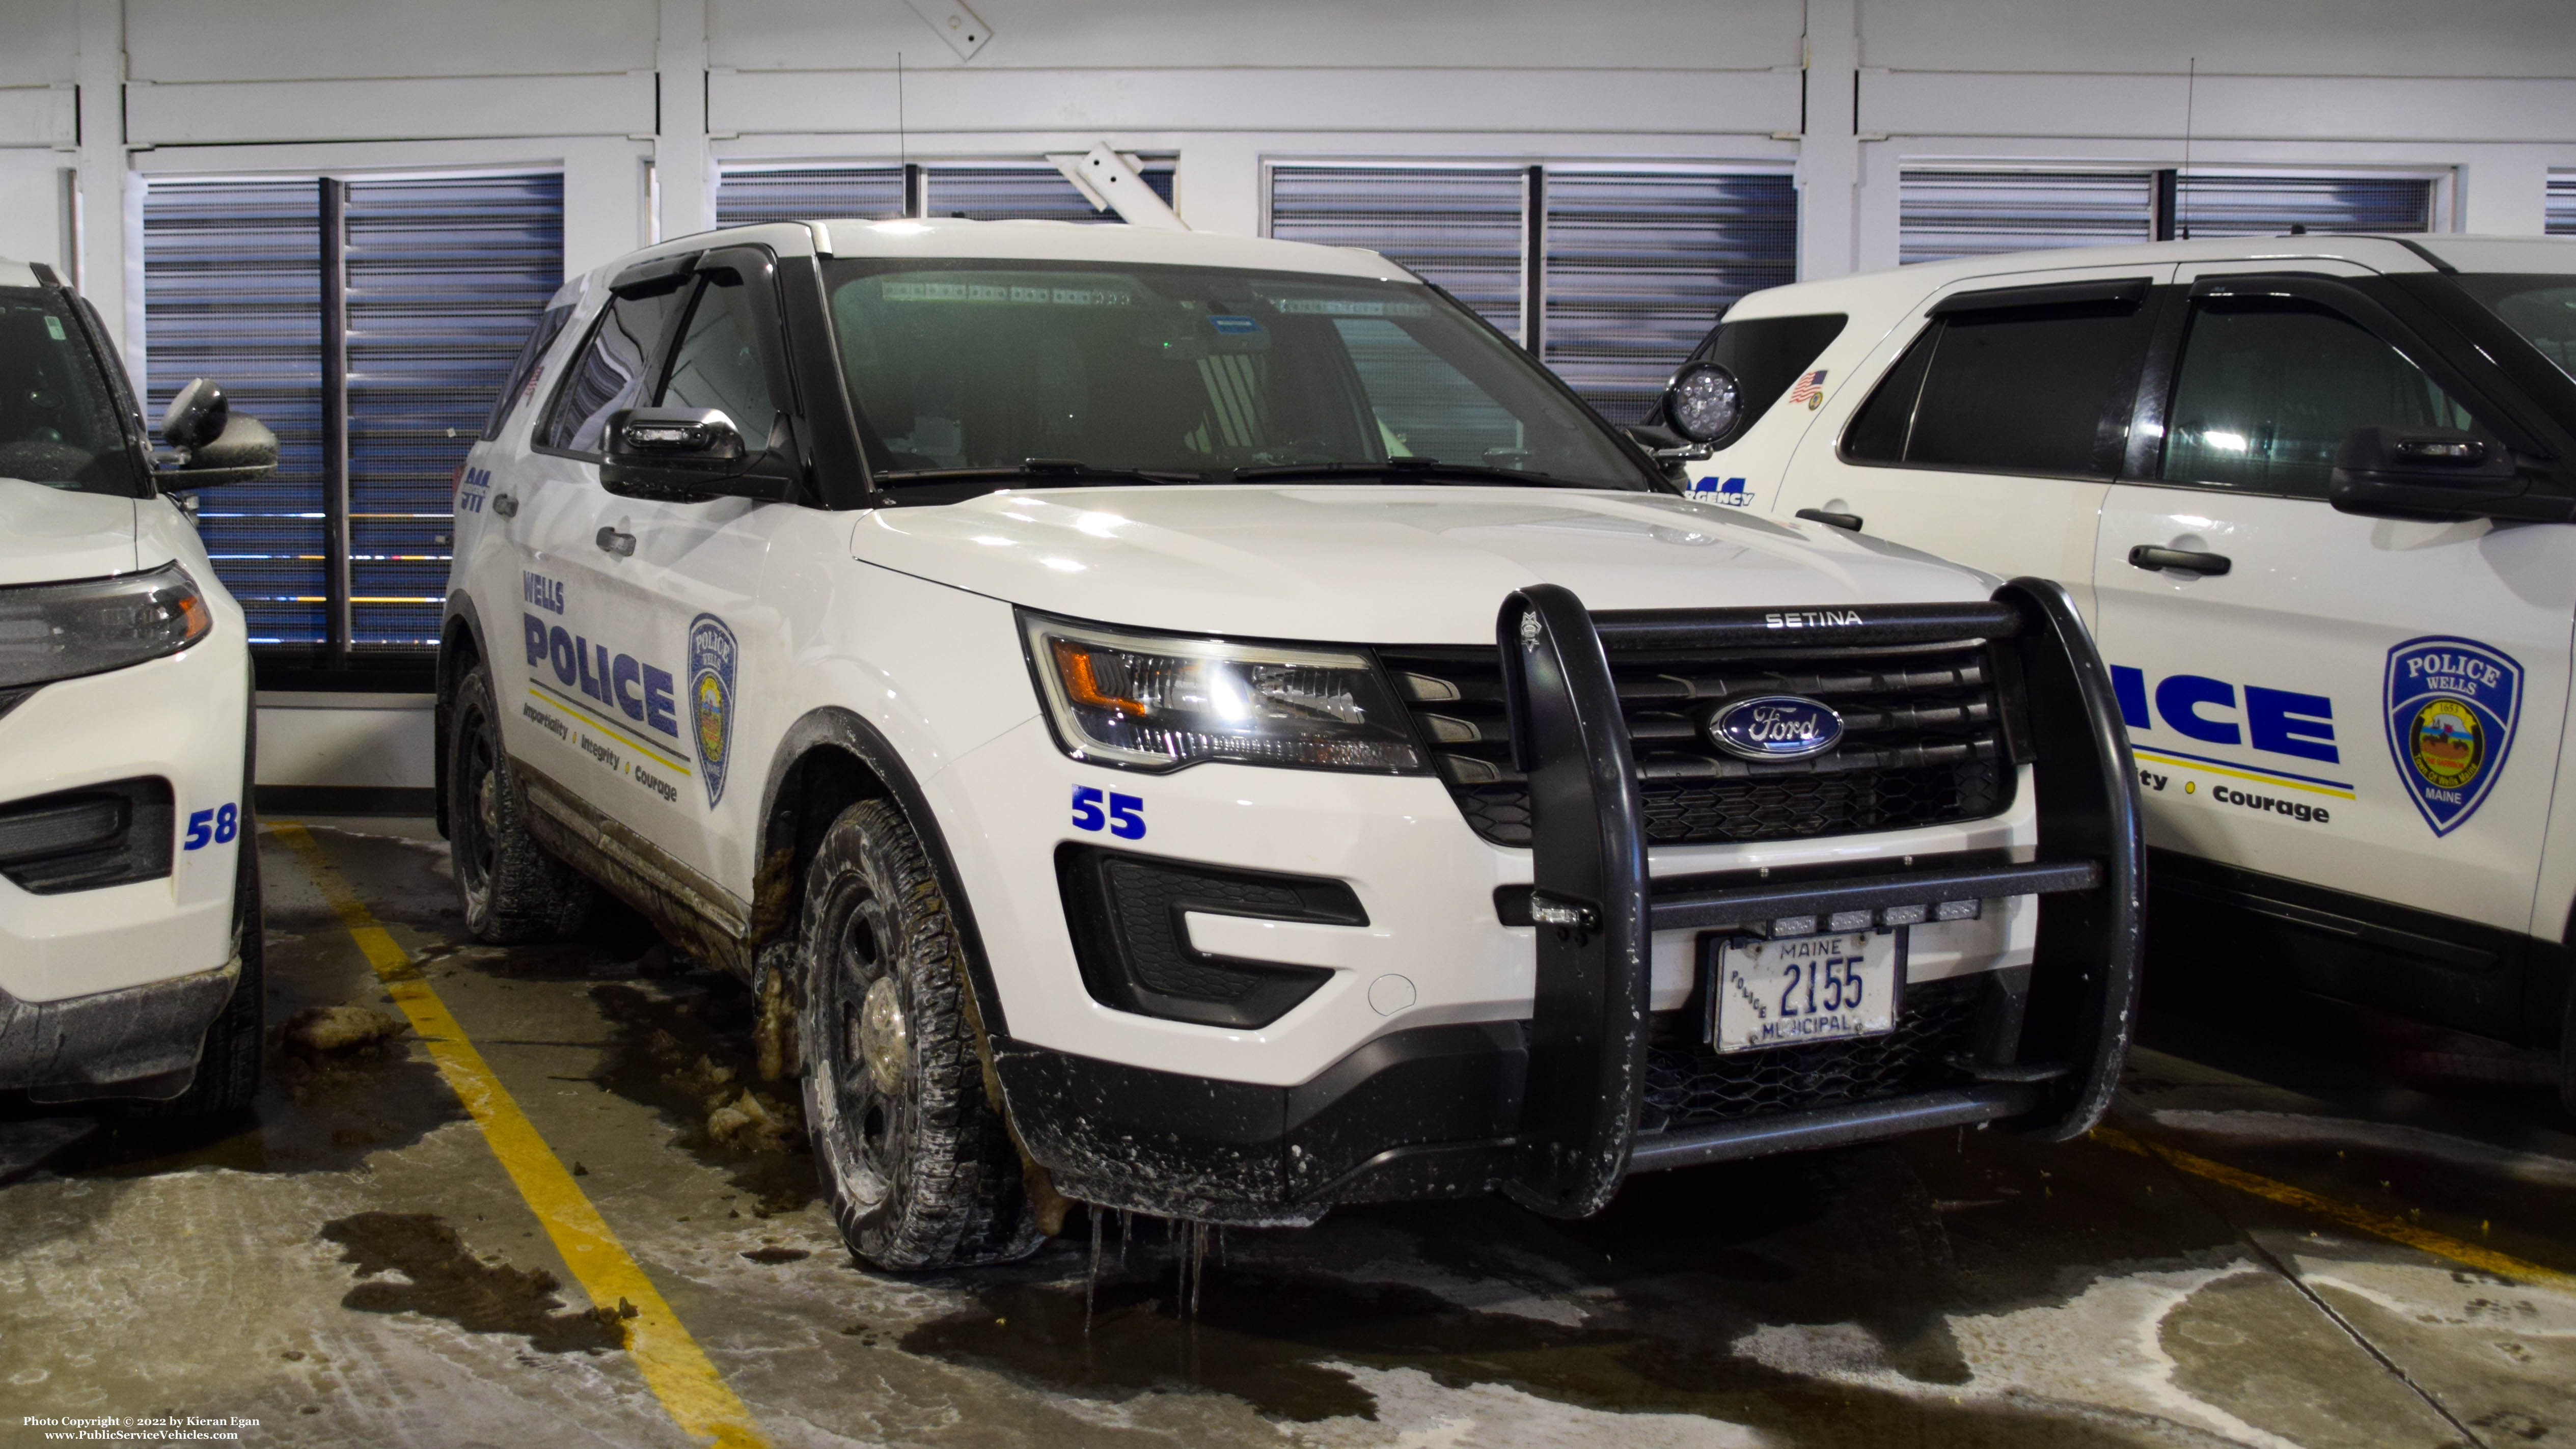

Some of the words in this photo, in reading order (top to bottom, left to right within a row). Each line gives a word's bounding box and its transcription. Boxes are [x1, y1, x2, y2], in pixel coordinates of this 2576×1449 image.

[524, 570, 564, 615] WELLS
[1766, 611, 1862, 628] SETINA
[696, 632, 729, 663] POLICE
[524, 612, 679, 739] POLICE
[2407, 654, 2501, 688] POLICE
[2426, 676, 2477, 695] WELLS
[1749, 706, 1821, 741] Ford
[2440, 703, 2458, 713] 1653
[523, 702, 568, 741] Impartiality
[581, 734, 620, 770] Integrity
[635, 765, 677, 802] Courage
[2425, 787, 2461, 805] MAINE
[2438, 777, 2459, 786] Wells
[1072, 783, 1146, 840] 55
[2212, 785, 2330, 824] Courage
[183, 802, 237, 851] 58
[1781, 939, 1842, 959] MAINE
[1731, 970, 1767, 1019] POLICE
[1781, 956, 1864, 1016] 2155
